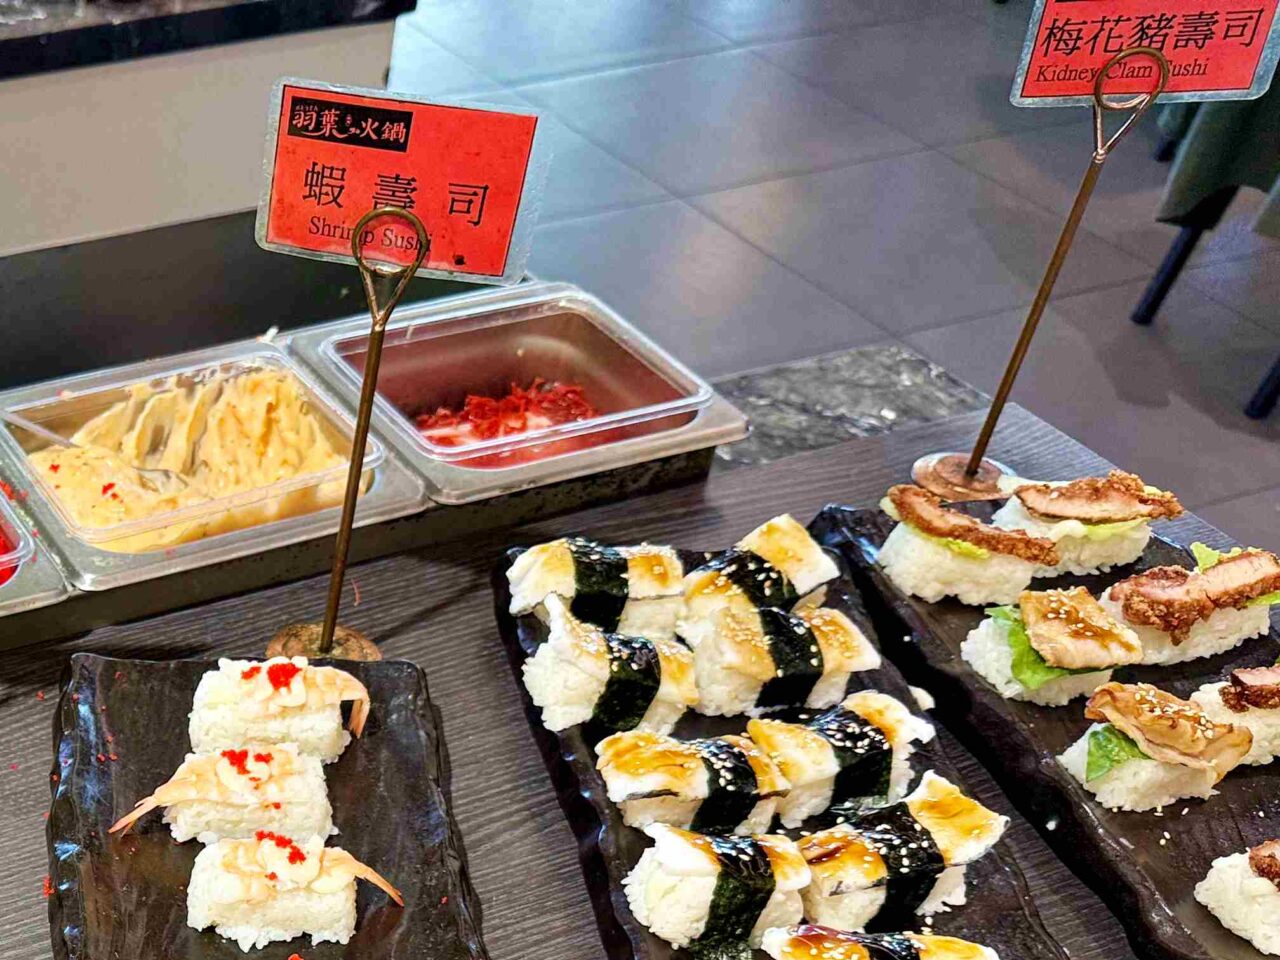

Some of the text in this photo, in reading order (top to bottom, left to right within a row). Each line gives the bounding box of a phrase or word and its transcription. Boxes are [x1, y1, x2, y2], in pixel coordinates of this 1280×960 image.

[1040, 8, 1264, 57] 梅花豬壽司
[1035, 63, 1100, 83] Kidney
[1106, 60, 1153, 79] Clam
